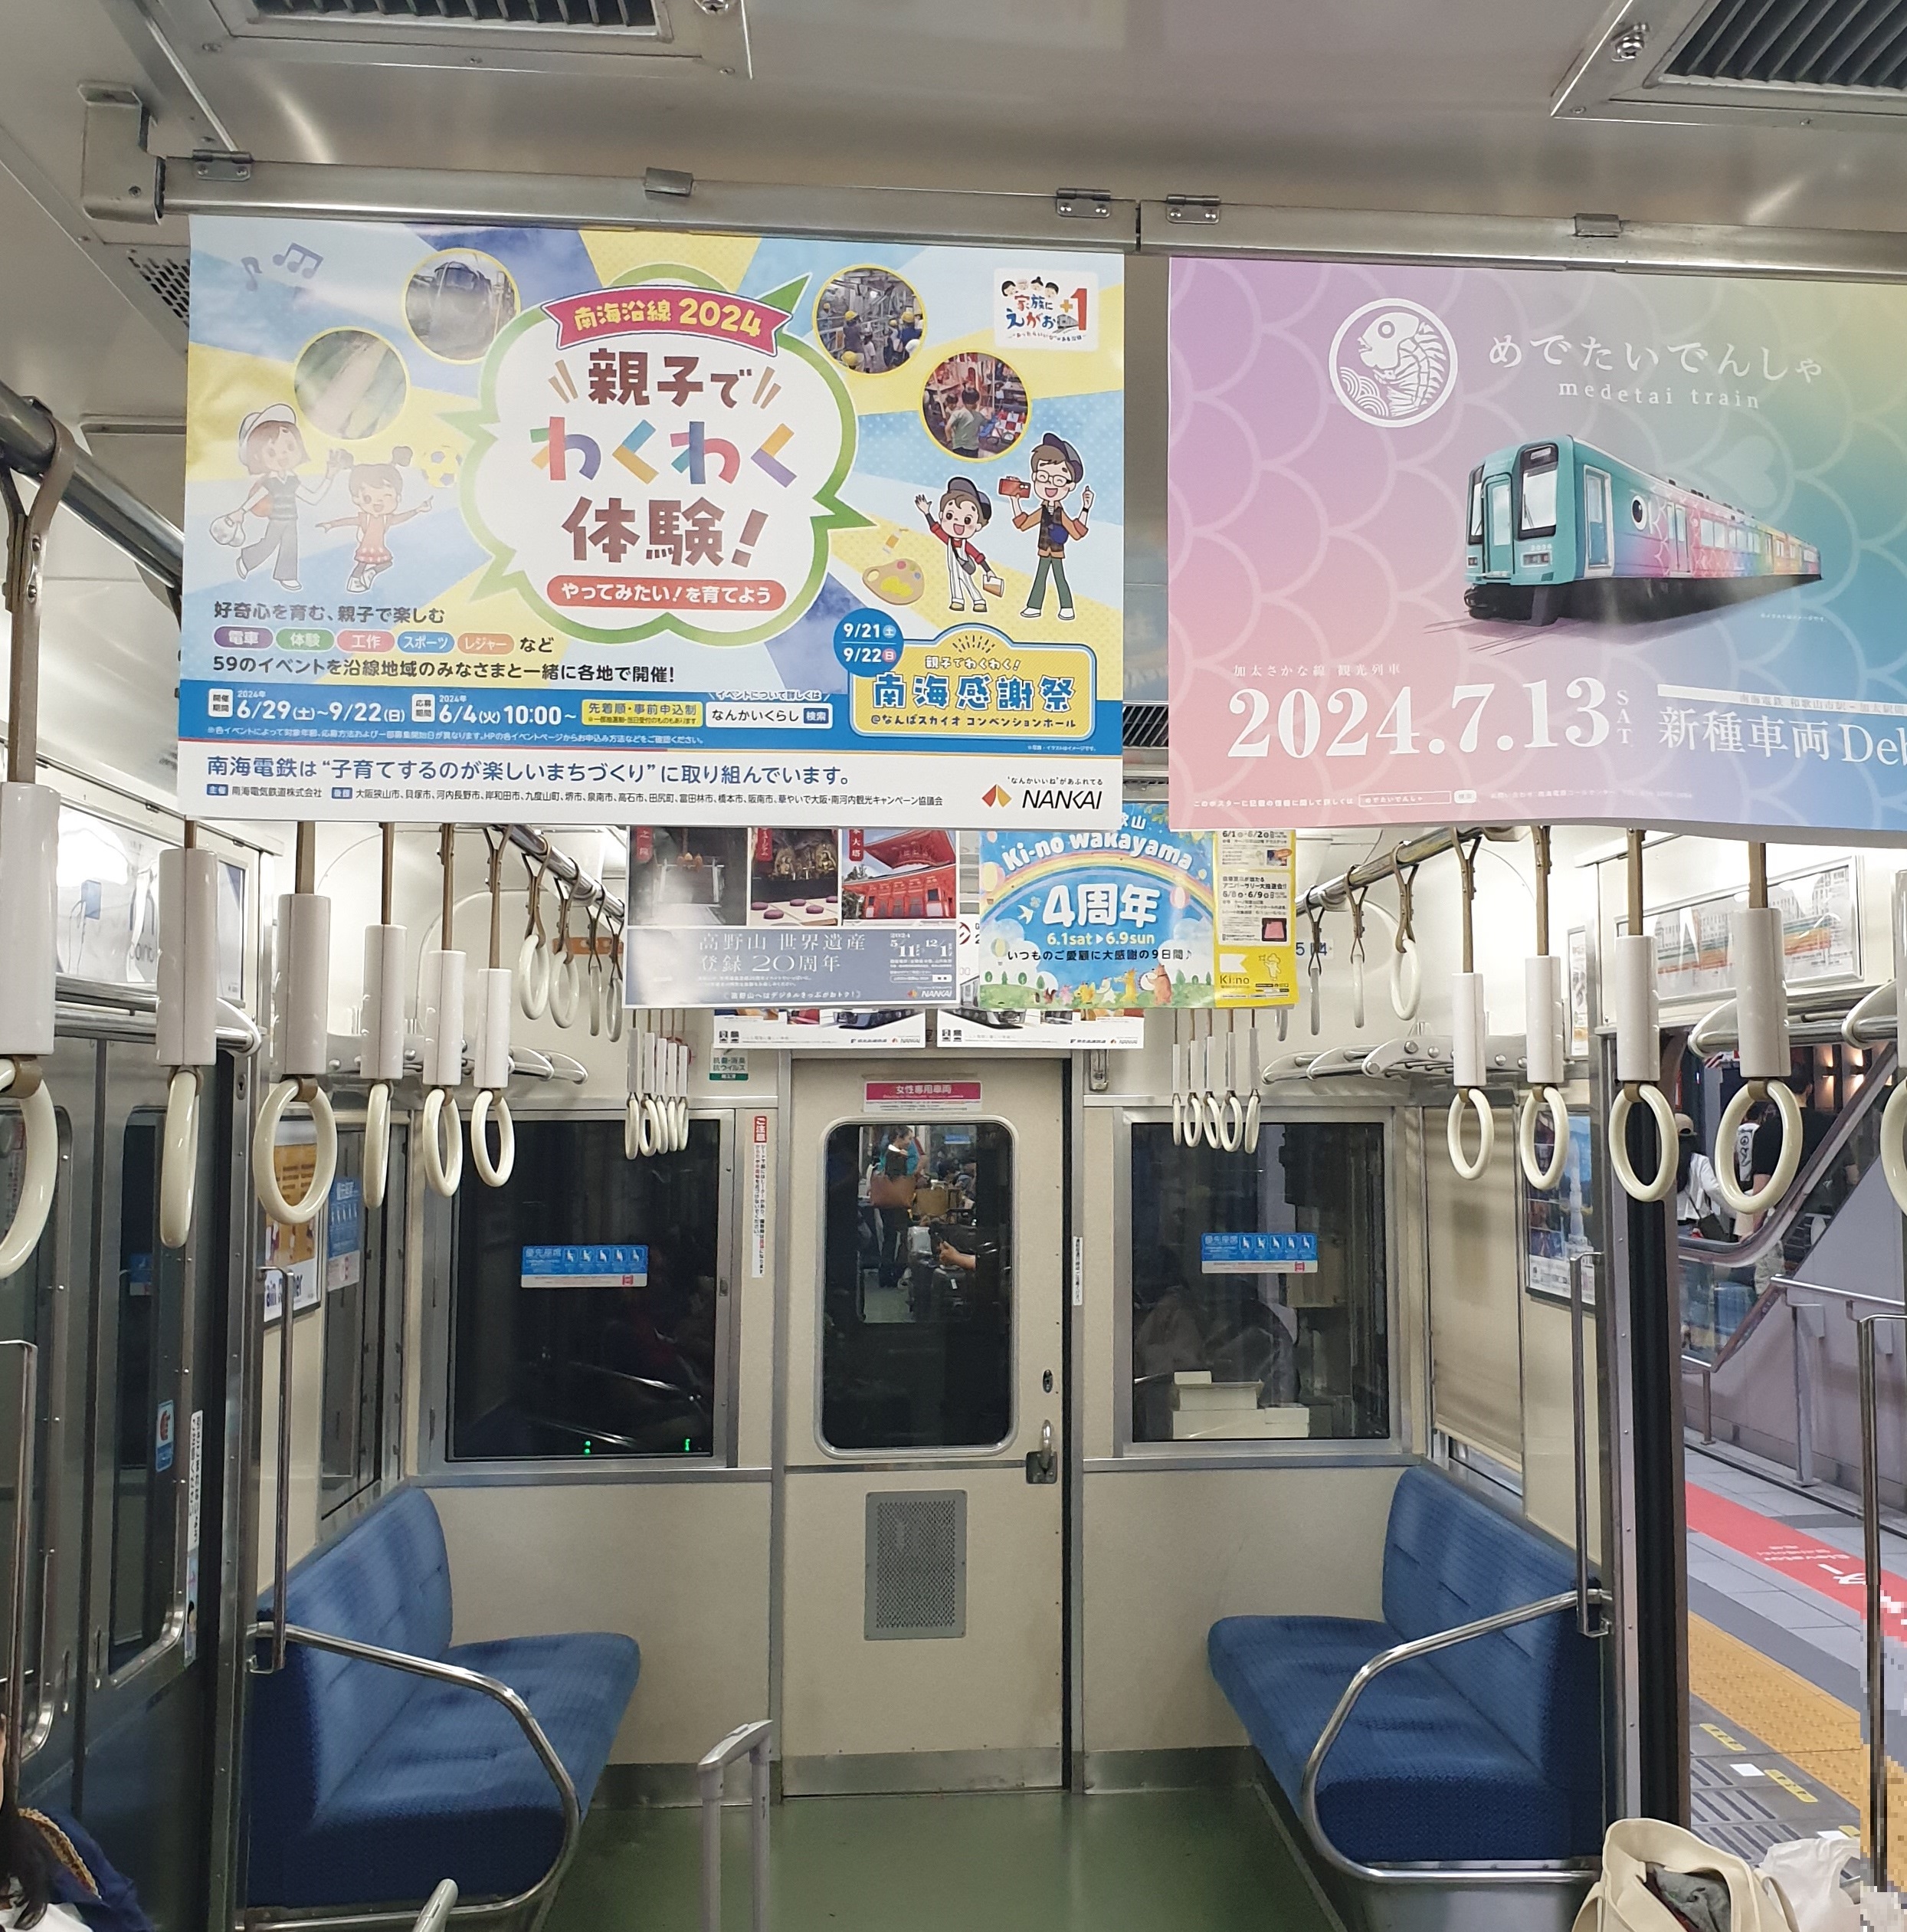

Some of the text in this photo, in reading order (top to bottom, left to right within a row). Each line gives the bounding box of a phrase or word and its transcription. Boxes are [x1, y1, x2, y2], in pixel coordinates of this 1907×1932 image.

[1014, 294, 1053, 312] 家族に
[575, 297, 762, 337] 南海沿線 2024
[1005, 307, 1057, 330] えがお
[1489, 333, 1823, 383] めでたいでんしゃ
[588, 347, 752, 408] 親子で
[1558, 381, 1760, 408] medetai train
[529, 415, 798, 489] わくわく
[561, 496, 769, 569] 体験!
[561, 582, 772, 605] やってみたい!を育てよう
[213, 600, 446, 625] 好奇心を育む、親子で楽しむ
[228, 629, 555, 654] 電車 体験 工作 スポーツ レジャー など
[843, 623, 881, 639] 9/21
[843, 648, 882, 664] 9/22
[925, 655, 1021, 671] 親子でわくわく!
[212, 654, 675, 684] 59のイベントを沿線地域のみなさまと一緒に各地で開催!
[1233, 662, 1401, 677] 加太さかな線 観光列車
[716, 690, 822, 701] イベントについて詳しくは
[873, 672, 1077, 713] 南海感謝祭
[439, 704, 500, 724] 6/4(火)
[712, 709, 799, 723] なんかいくらし
[871, 713, 1076, 728] @なんばスカイオ コンベンションホール
[1227, 677, 1610, 759] 2024.7.13
[1659, 706, 1830, 760] 新種車両
[232, 786, 322, 798] 南海電気鉄道株式会社
[1022, 790, 1101, 809] NANKAI
[1002, 832, 1193, 871] Ki-no wakayama
[1043, 884, 1160, 928] 4周年
[700, 933, 866, 950] 高野山 世界遺産
[1047, 932, 1155, 946] 6.1sat 6.9sun
[752, 955, 840, 972] 20周年
